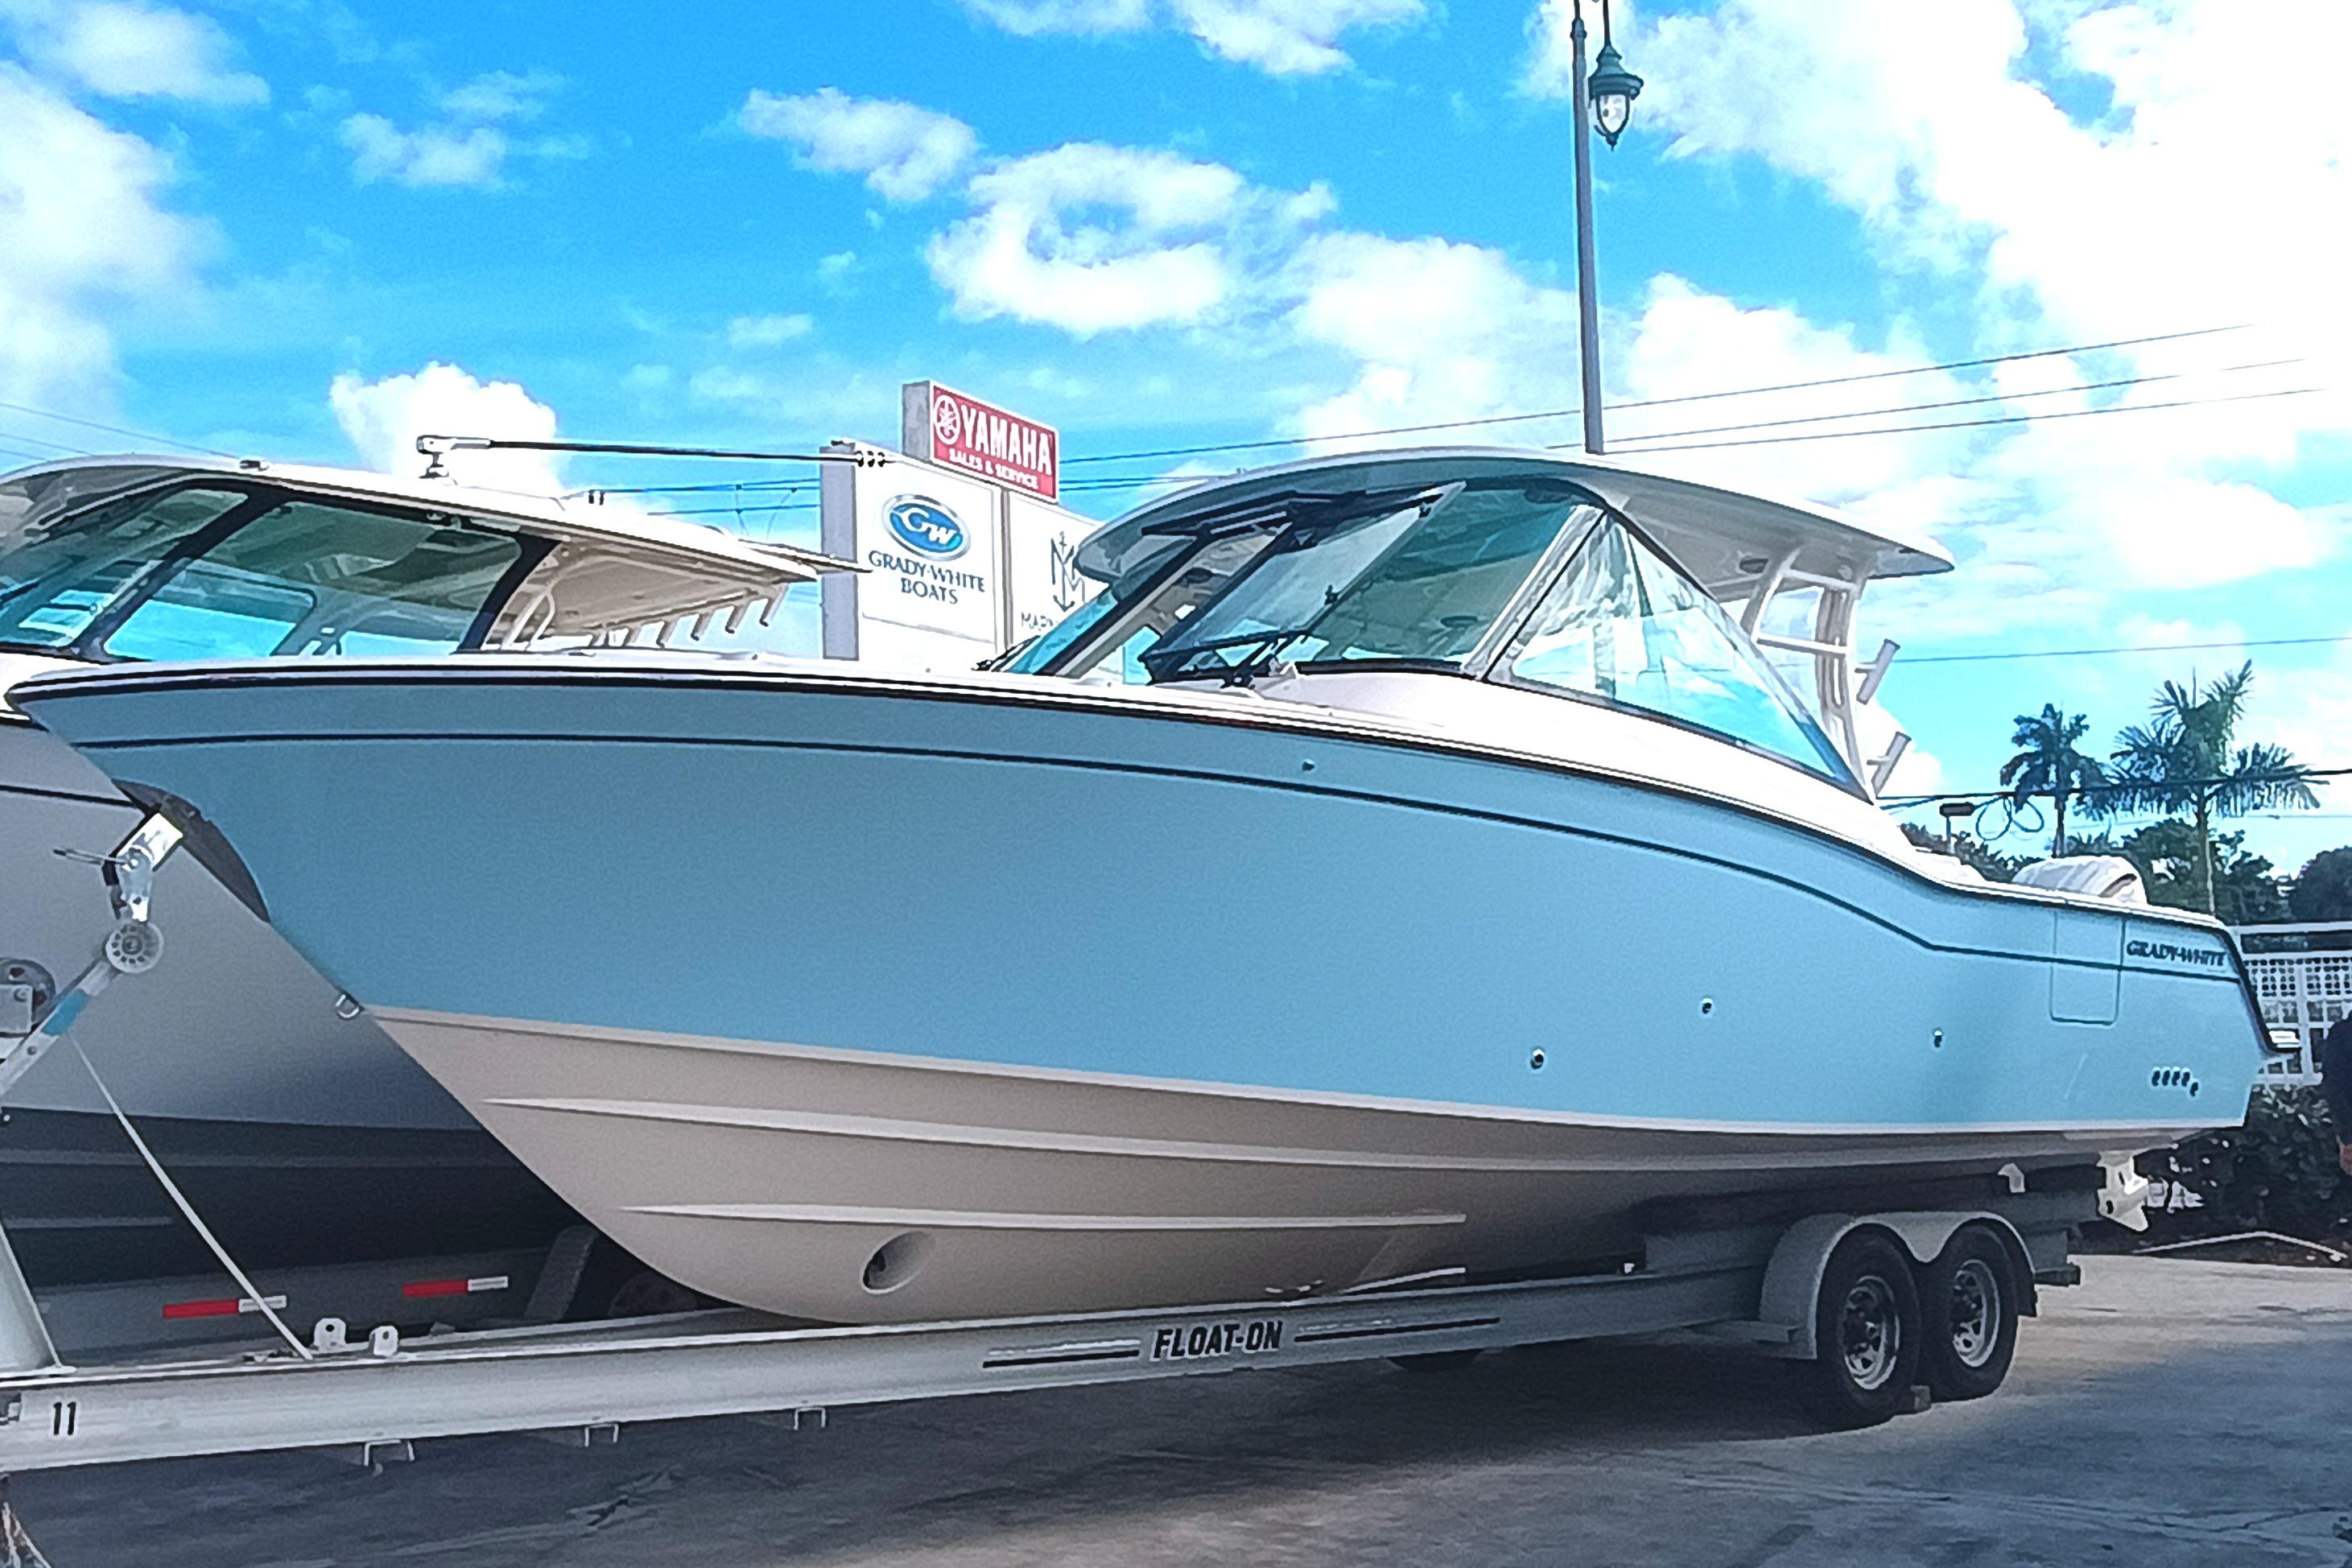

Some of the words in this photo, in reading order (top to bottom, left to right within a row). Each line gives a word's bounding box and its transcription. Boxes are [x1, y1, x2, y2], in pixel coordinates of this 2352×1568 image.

[960, 404, 1052, 475] YAMAHA
[949, 448, 983, 471] SALES
[901, 577, 958, 605] BOATS
[1153, 1321, 1283, 1359] FLOAT-ON
[53, 1401, 76, 1435] 11
